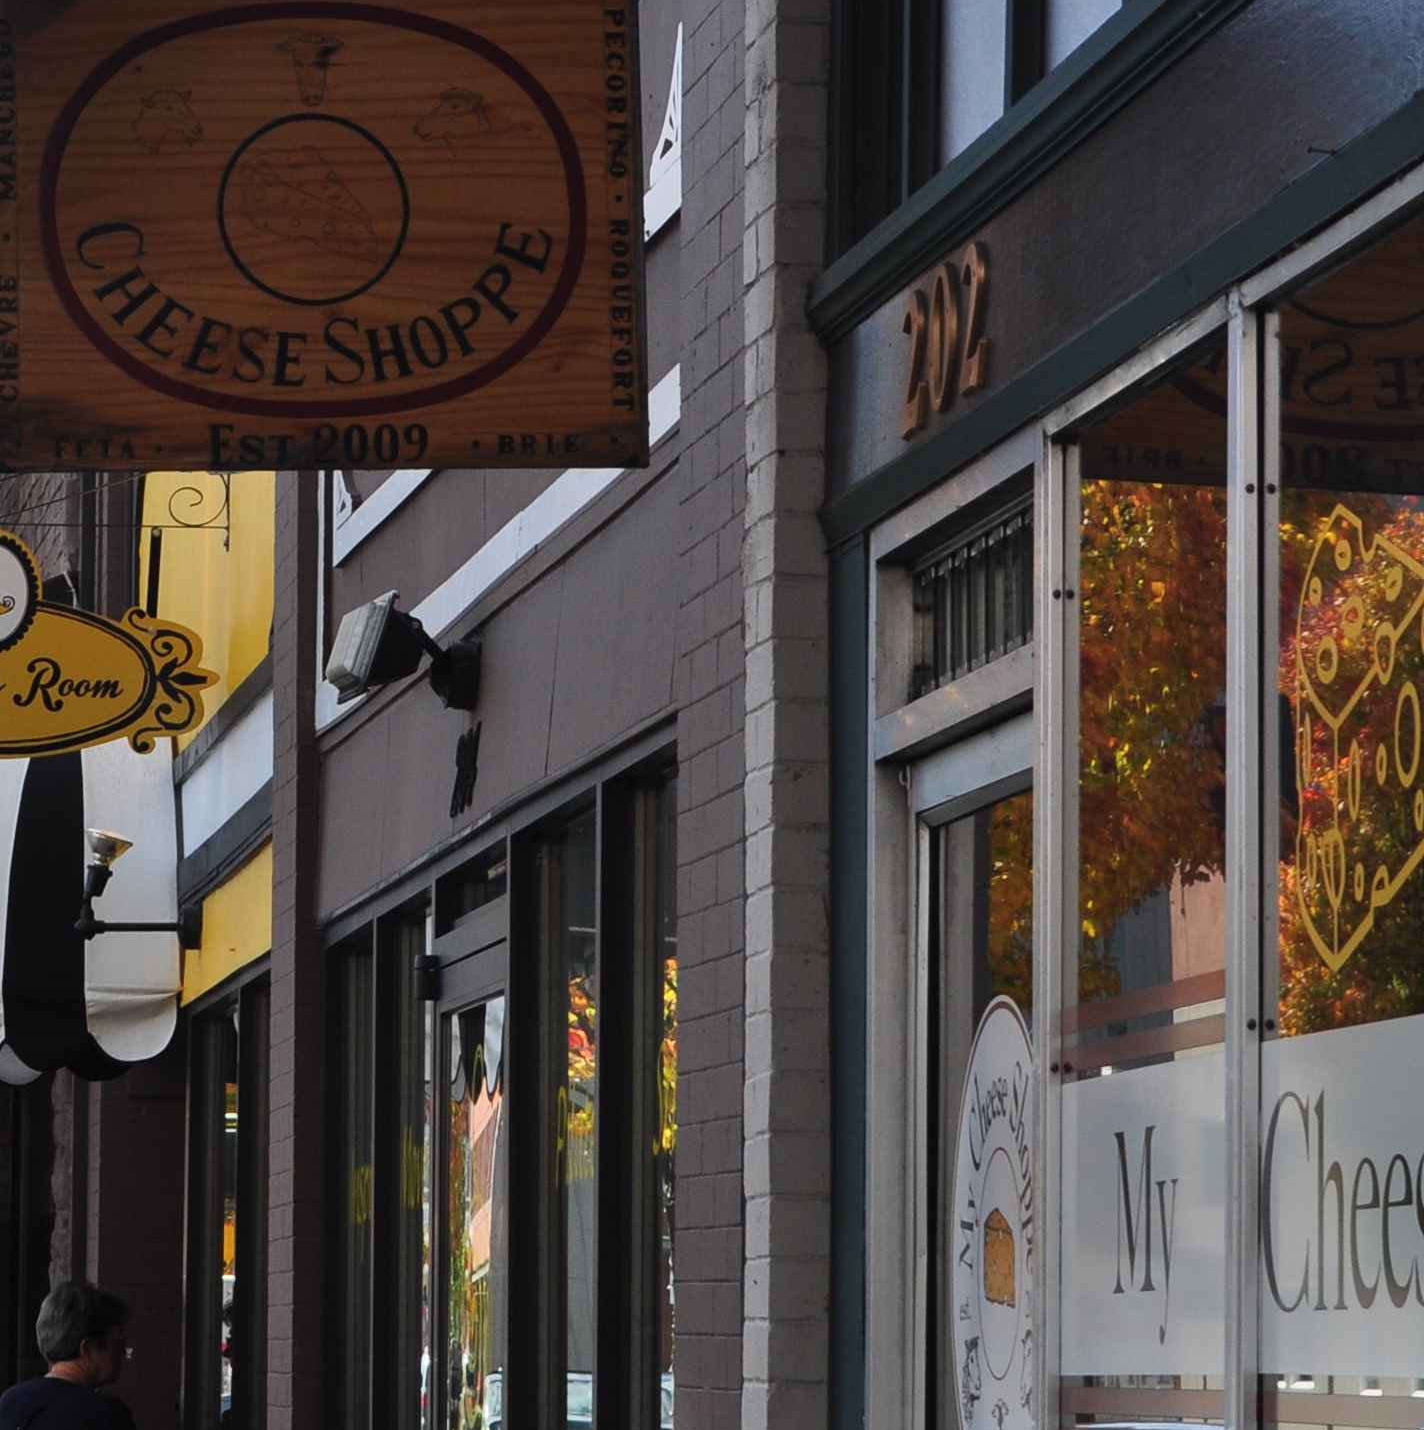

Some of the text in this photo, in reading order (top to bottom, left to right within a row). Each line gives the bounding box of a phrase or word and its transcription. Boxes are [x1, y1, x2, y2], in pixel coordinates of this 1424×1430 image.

[603, 7, 635, 412] PECORINO ROQUEFORT
[76, 222, 554, 388] CHEESE SHOPPE
[902, 241, 989, 441] 202
[52, 438, 137, 460] FETA
[312, 422, 429, 466] 2009
[497, 434, 582, 456] BRIE
[12, 657, 124, 713] Room
[1112, 1124, 1179, 1346] My
